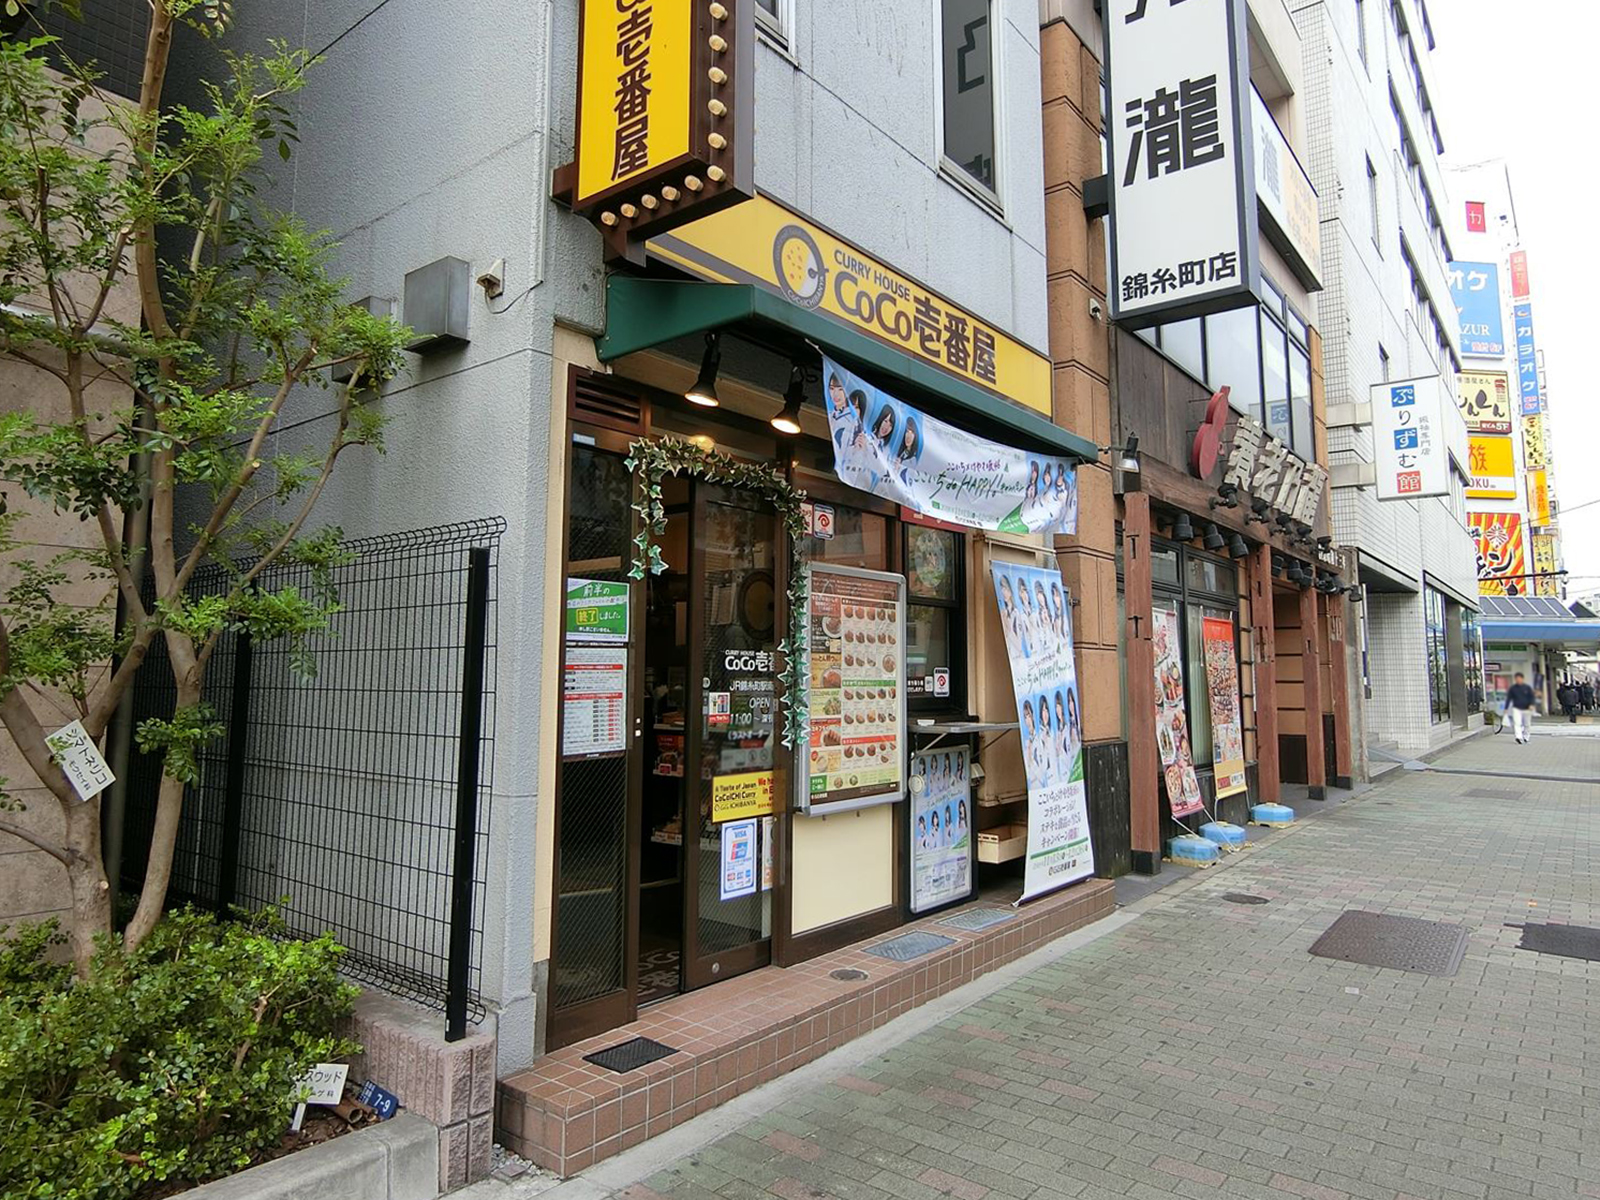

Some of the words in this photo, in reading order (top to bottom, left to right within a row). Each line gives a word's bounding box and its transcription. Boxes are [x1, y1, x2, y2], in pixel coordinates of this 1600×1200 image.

[1468, 210, 1482, 225] カ
[834, 249, 871, 281] CURRY
[873, 269, 911, 302] HOUSE
[1121, 251, 1237, 303] 錦糸町店
[834, 271, 997, 386] CoCo壱番屋
[1517, 326, 1536, 393] カラオケ
[1392, 387, 1421, 491] ぷりずむ館
[749, 697, 771, 709] OPEN
[730, 713, 752, 726] 11:00
[65, 728, 108, 785] シマトネリコ
[720, 783, 735, 792] Taste
[742, 781, 757, 790] Japan
[742, 791, 756, 800] Curry
[734, 830, 748, 840] VISA
[373, 1092, 392, 1113] 7-9
